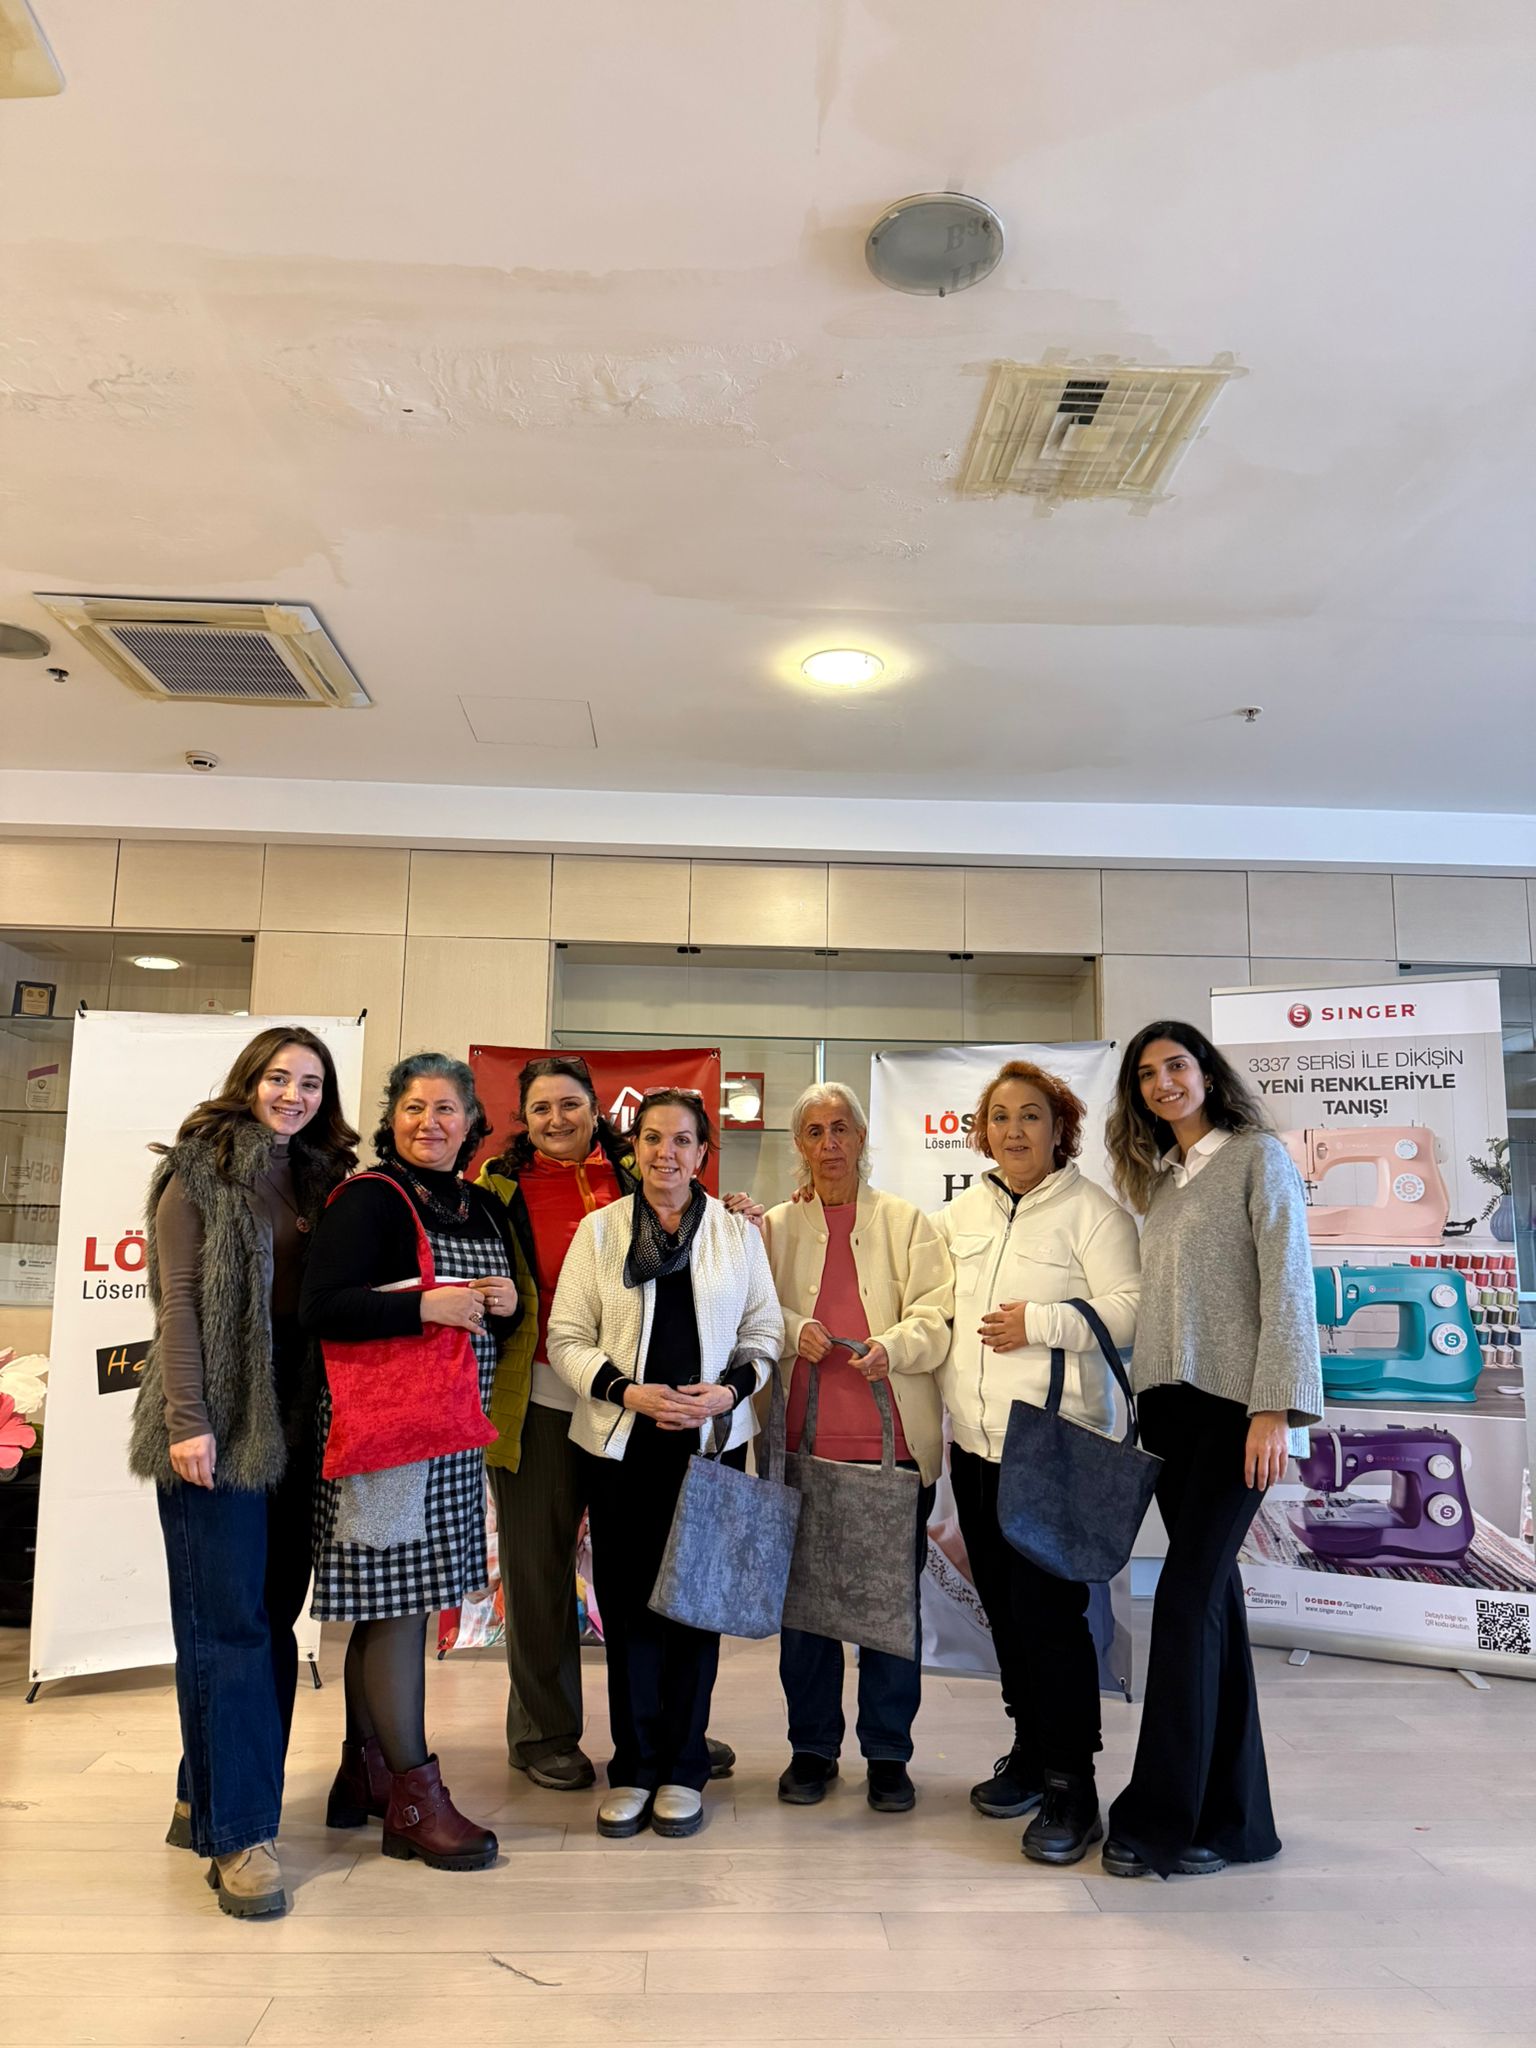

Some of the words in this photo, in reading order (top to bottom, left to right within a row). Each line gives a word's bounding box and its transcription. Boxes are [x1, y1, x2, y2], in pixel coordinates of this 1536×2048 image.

[1321, 1003, 1415, 1021] SINGER
[1249, 1056, 1290, 1072] 3337
[1297, 1051, 1355, 1071] SERİSİ
[1362, 1050, 1389, 1068] İLE
[1395, 1047, 1464, 1069] DİKİŞİN
[1257, 1075, 1304, 1094] YENİ
[1311, 1072, 1456, 1092] RENKLERİYLE
[1323, 1099, 1388, 1118] TANIŞ!
[84, 1230, 149, 1272] LÖ
